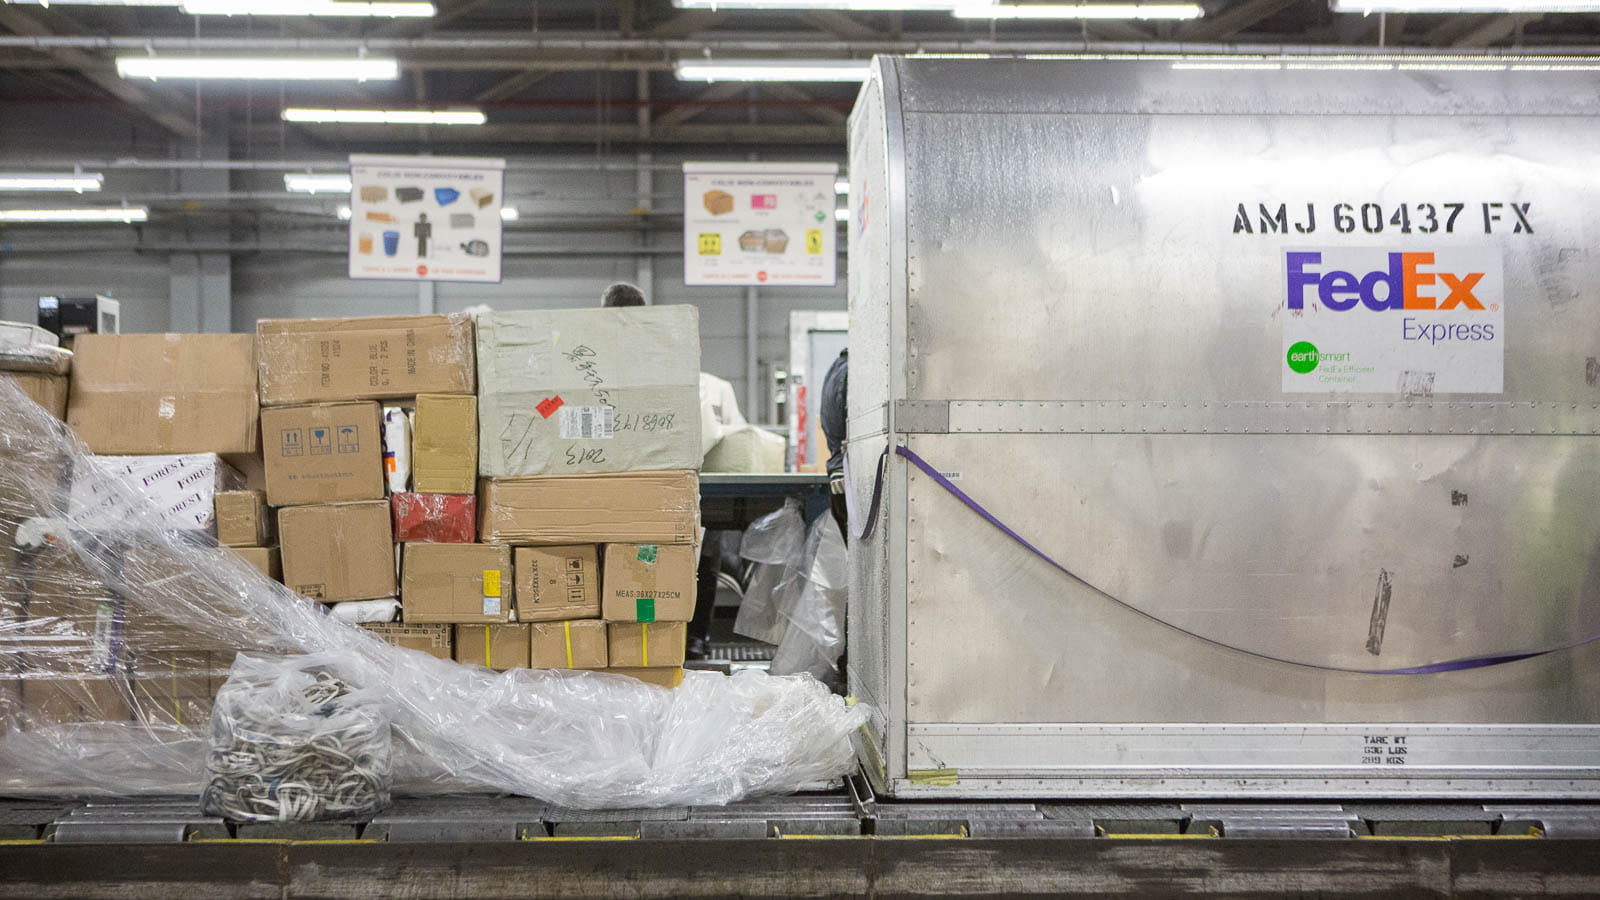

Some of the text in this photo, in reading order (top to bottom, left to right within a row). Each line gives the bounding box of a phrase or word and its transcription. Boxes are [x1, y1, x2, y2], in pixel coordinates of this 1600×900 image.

[1232, 202, 1535, 234] AMJ 60437 FX
[1286, 252, 1486, 312] FedEx
[1403, 317, 1495, 345] Express
[565, 442, 606, 466] 2013
[142, 457, 186, 487] FOREST
[1364, 735, 1388, 744] TARE
[1388, 746, 1407, 755] LBS
[1386, 756, 1405, 764] KGS
